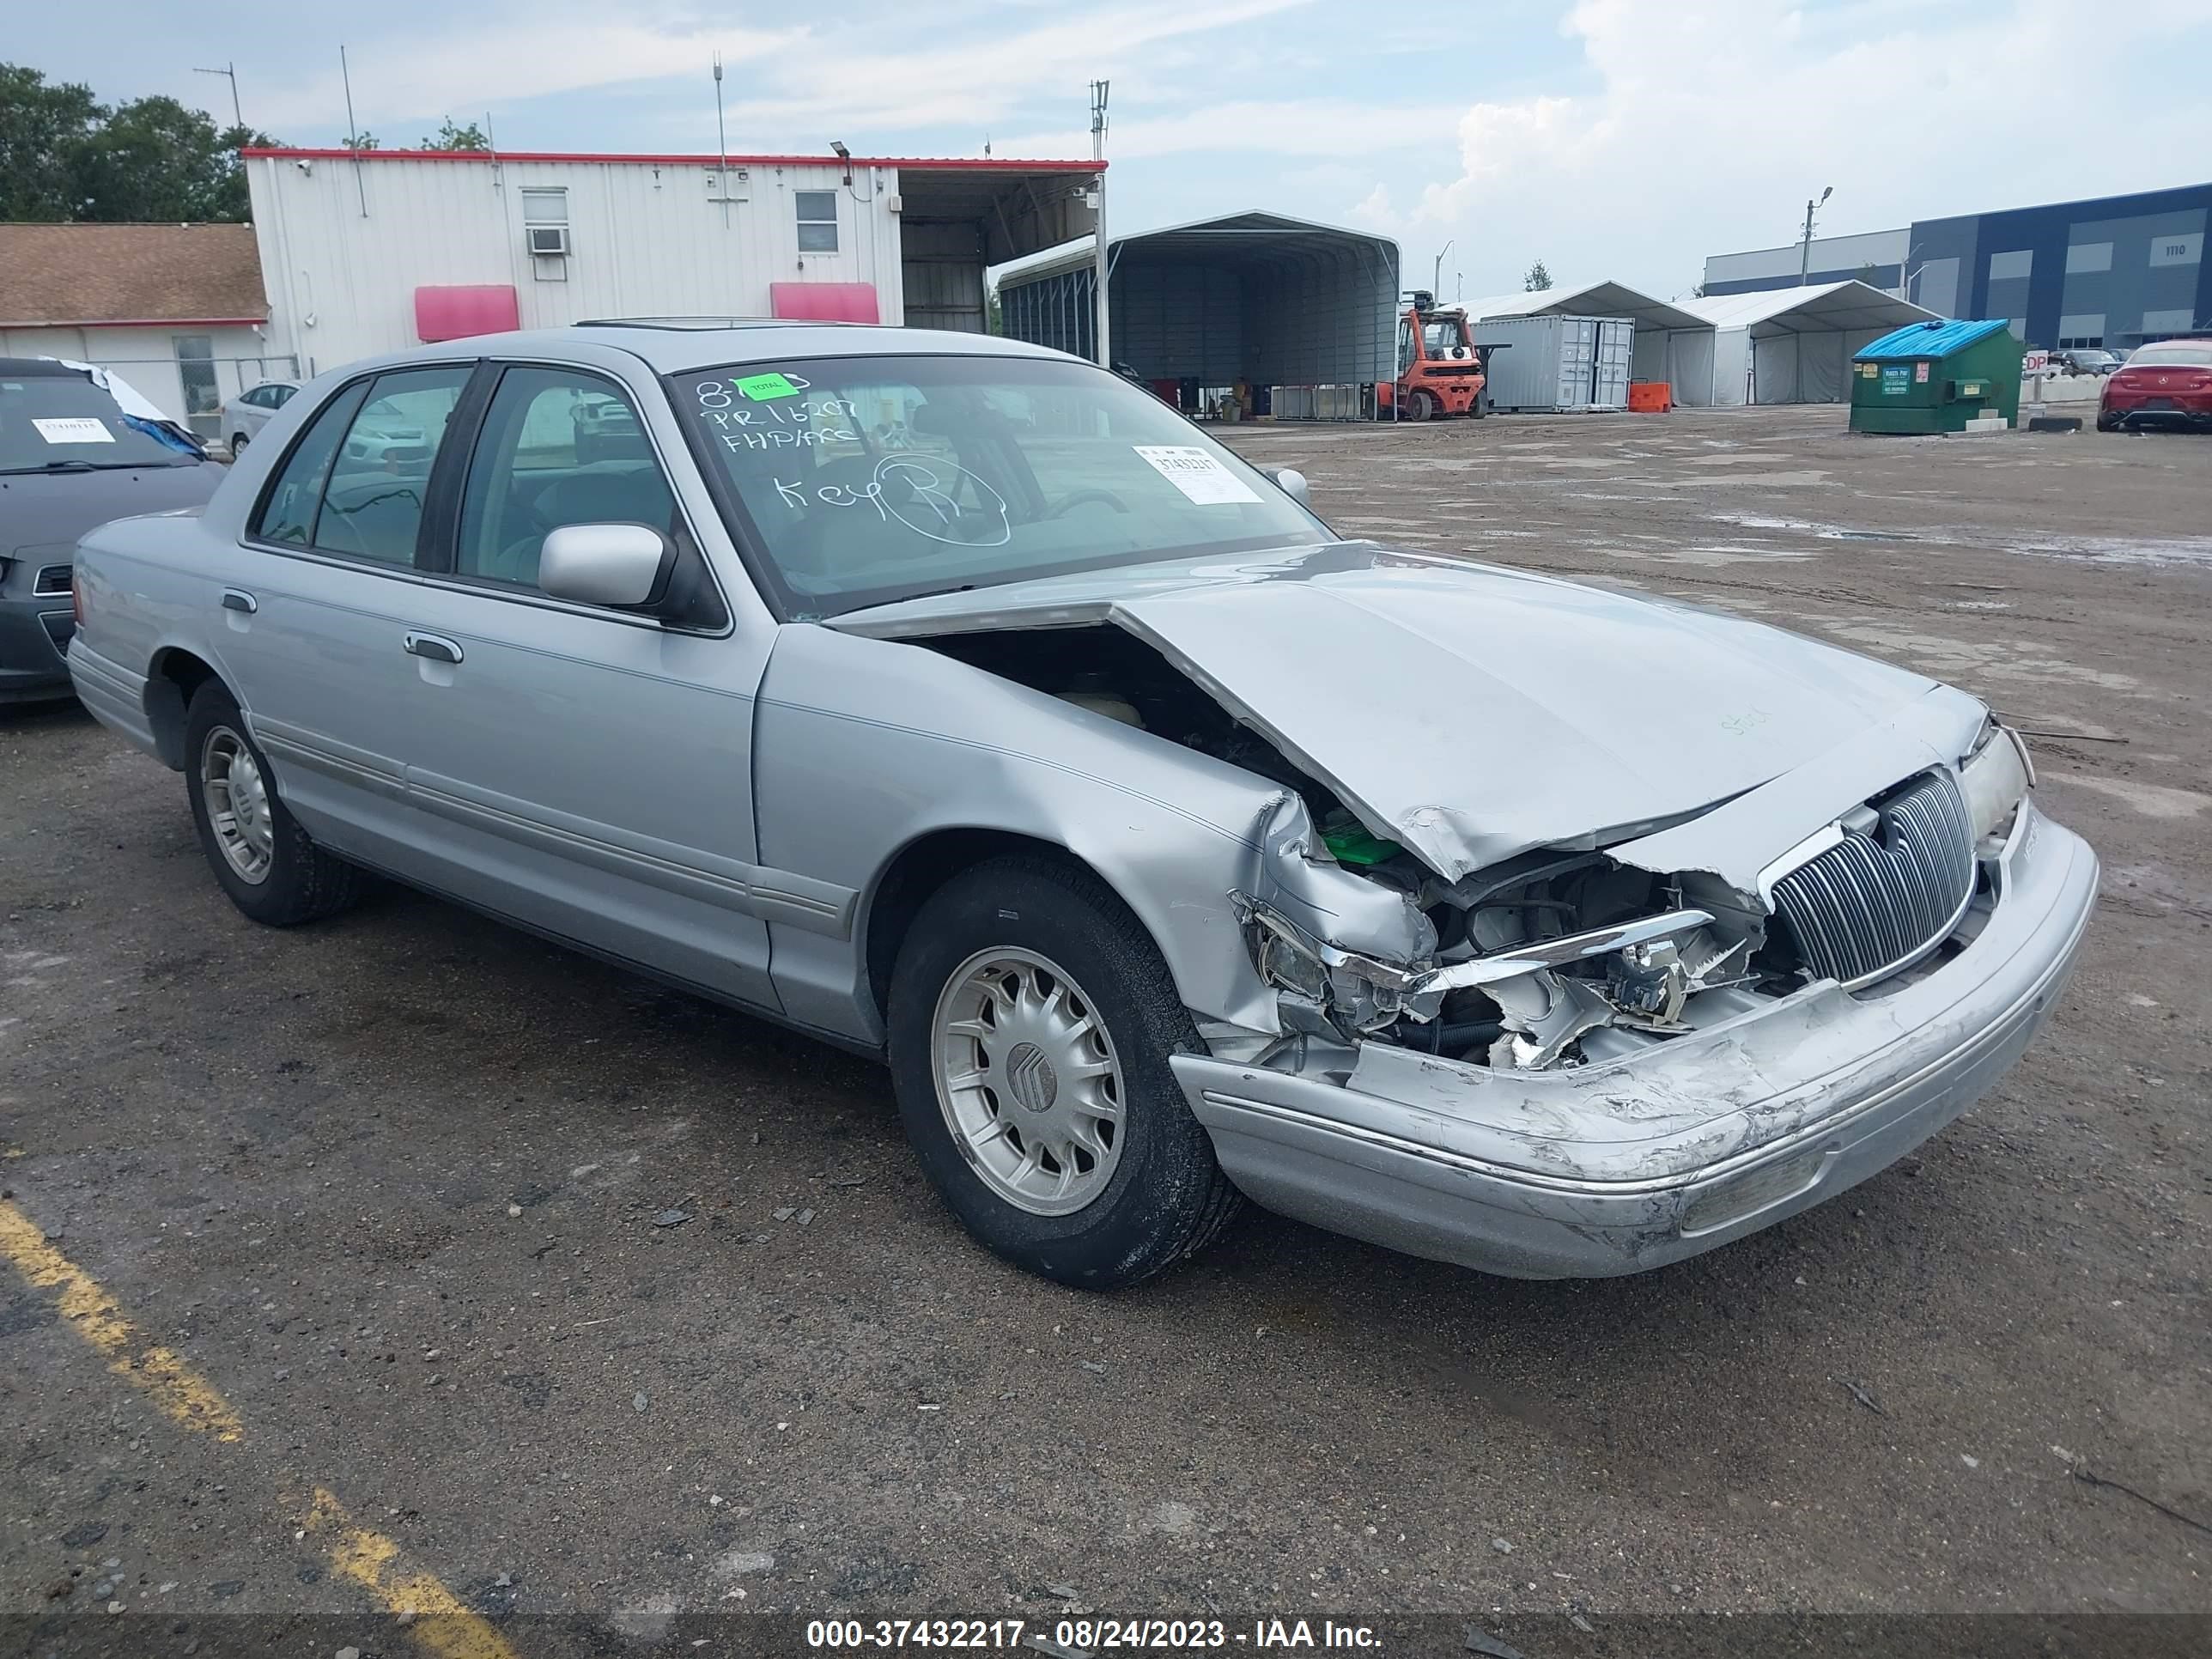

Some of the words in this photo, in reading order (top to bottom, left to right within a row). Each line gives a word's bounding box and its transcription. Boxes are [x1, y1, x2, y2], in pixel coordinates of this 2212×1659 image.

[2166, 245, 2186, 257] 1110
[2027, 356, 2046, 370] DP
[1155, 459, 1218, 470] 37432217
